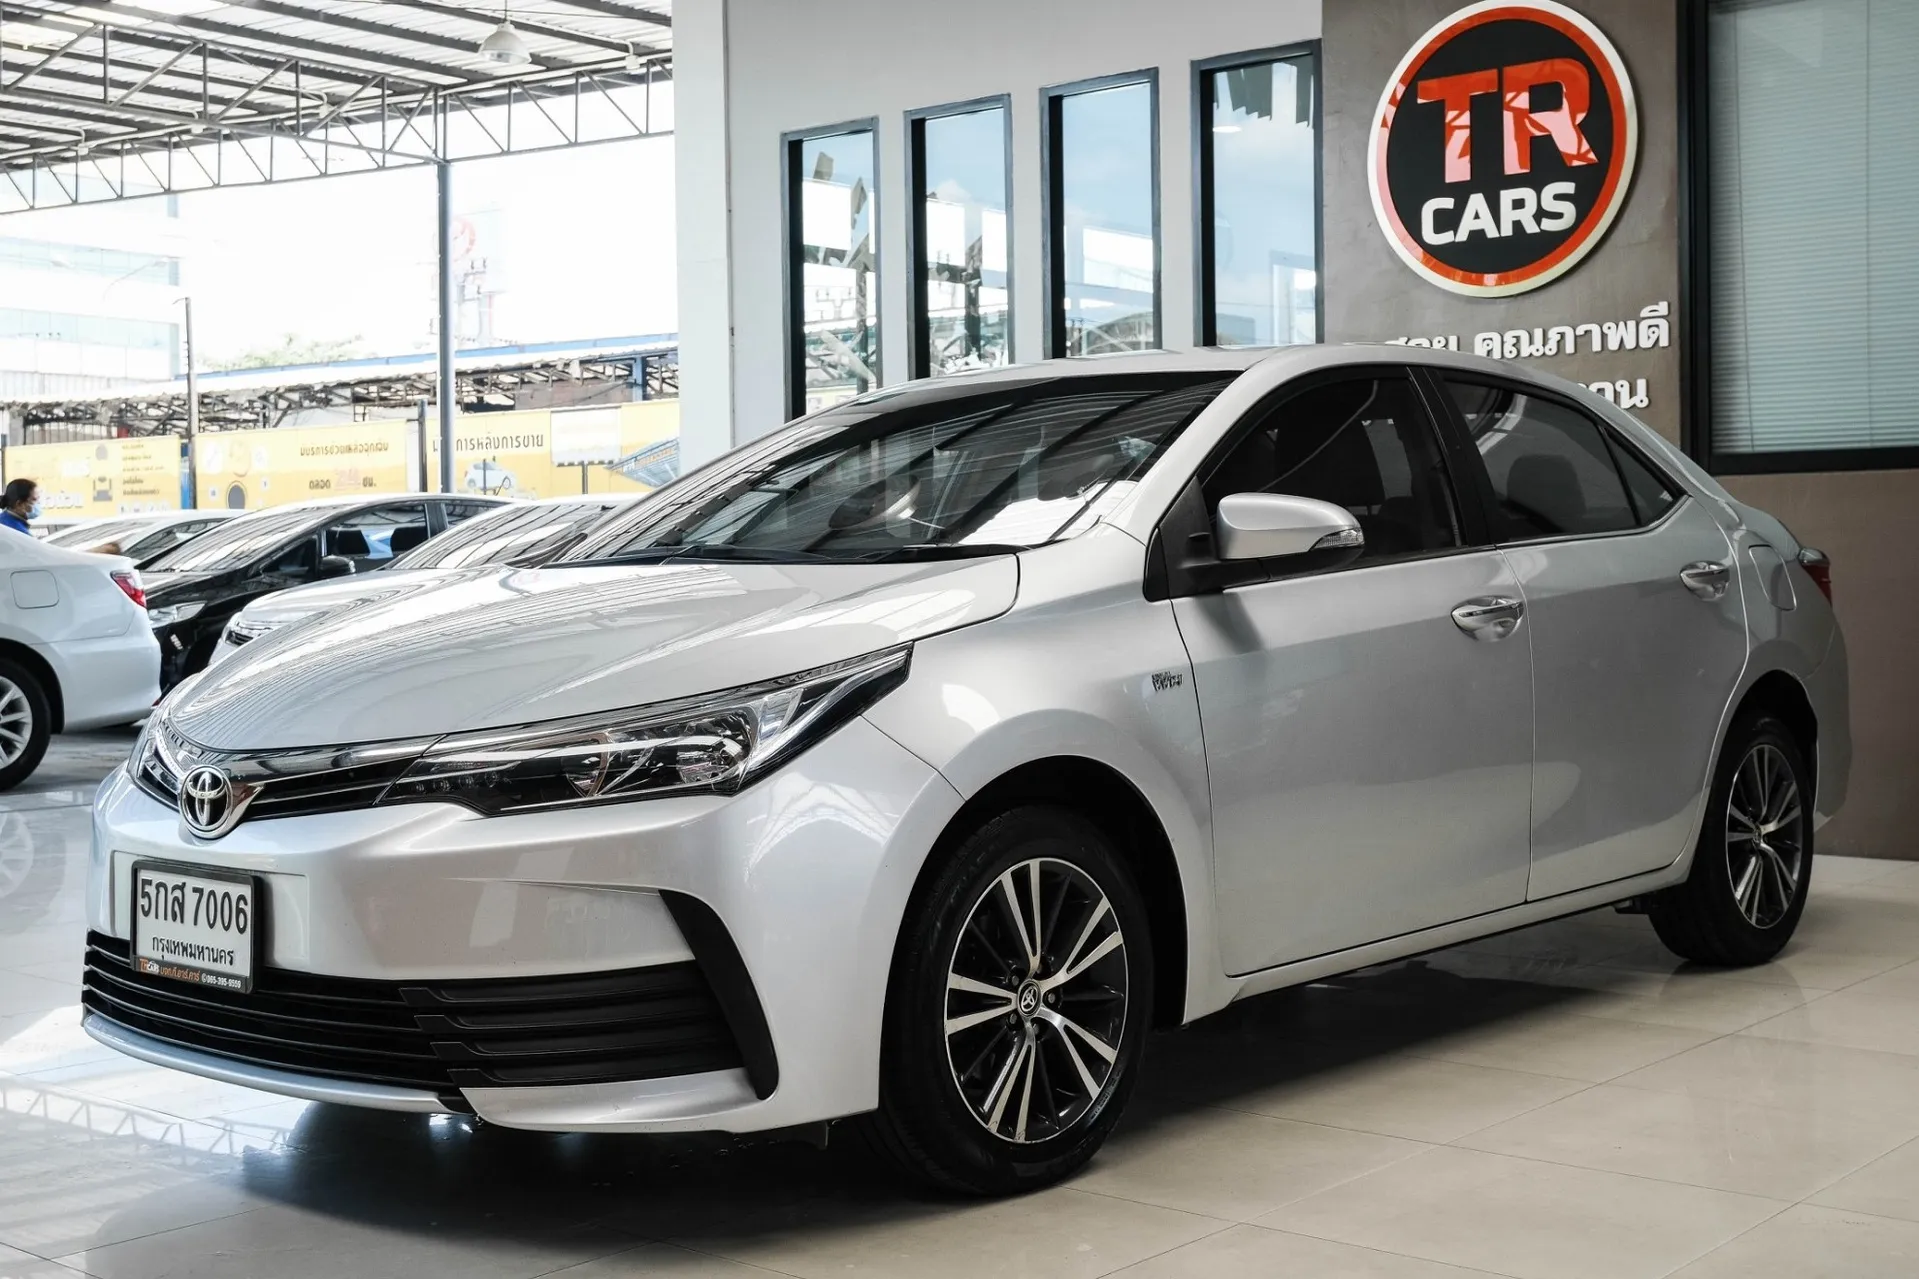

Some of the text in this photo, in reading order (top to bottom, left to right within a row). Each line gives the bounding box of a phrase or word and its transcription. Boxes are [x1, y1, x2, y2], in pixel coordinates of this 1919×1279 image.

[1417, 57, 1599, 184] TR
[1420, 181, 1577, 246] CARS
[1473, 301, 1670, 360] คณภาพดี
[140, 878, 249, 935] 5กส 7006
[152, 935, 235, 966] กรุงเทพมหานคร
